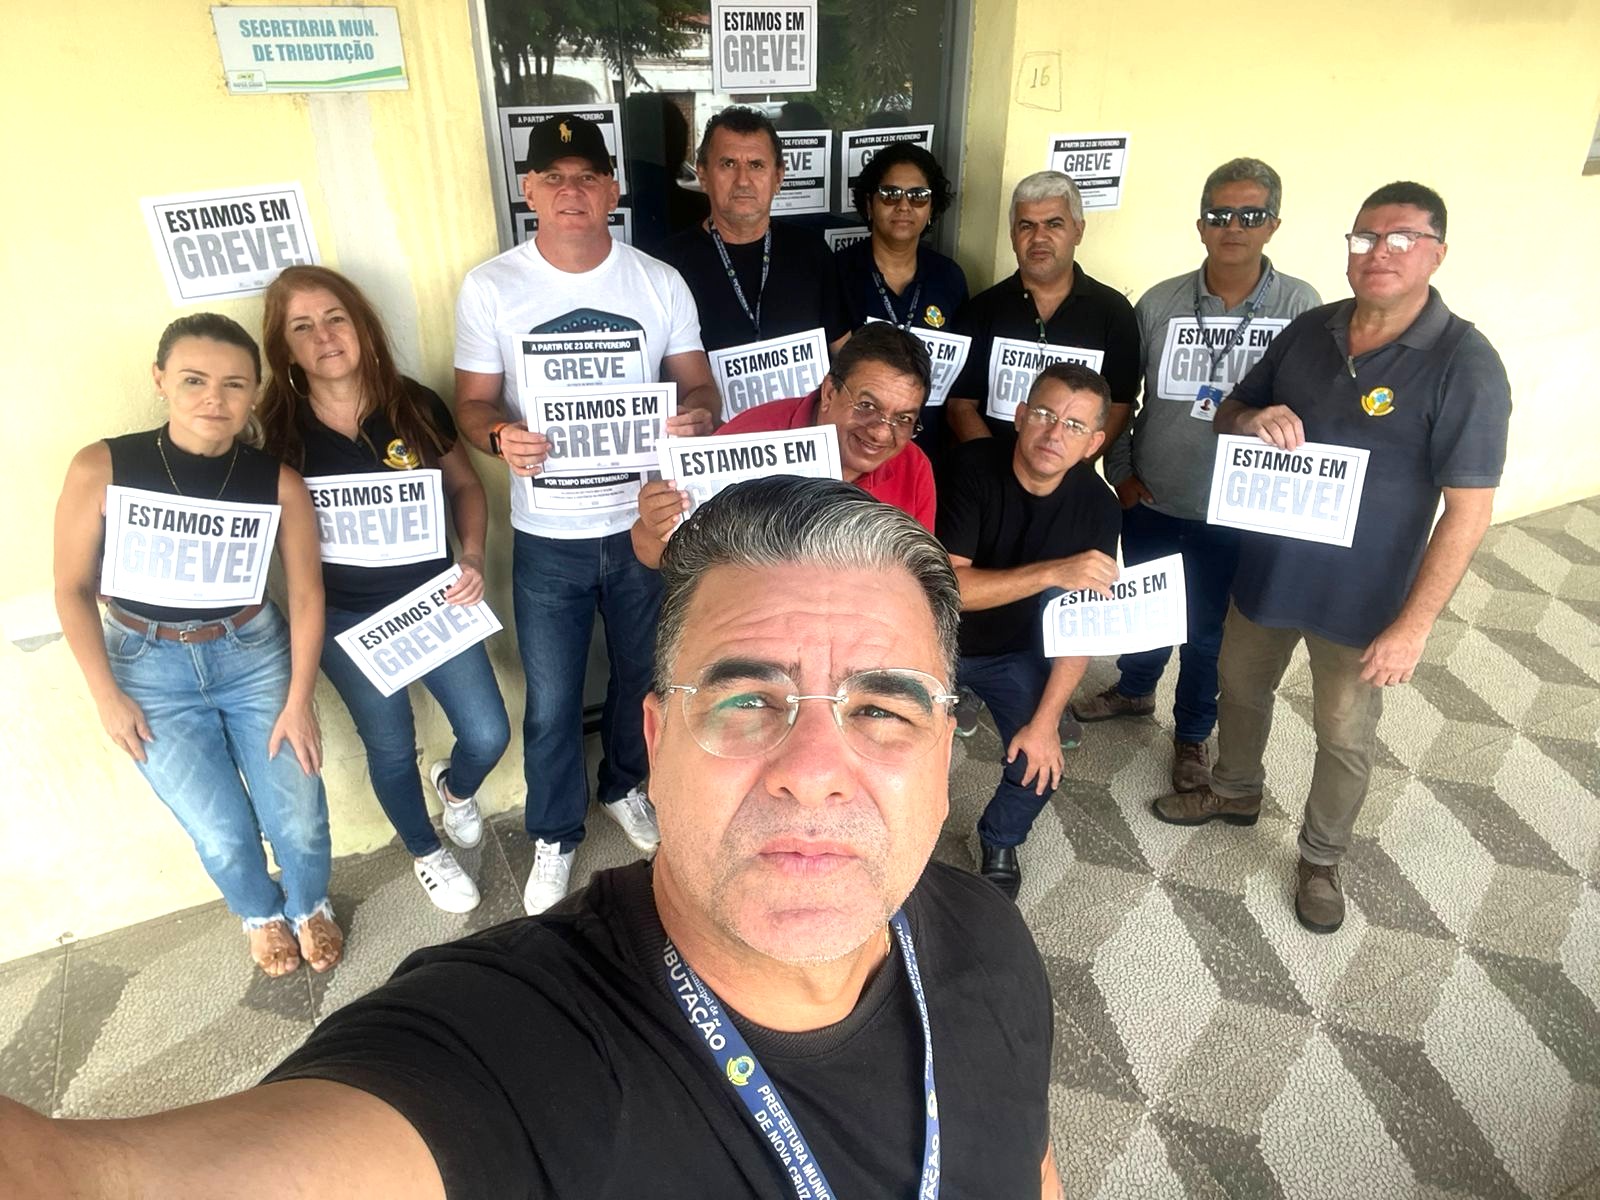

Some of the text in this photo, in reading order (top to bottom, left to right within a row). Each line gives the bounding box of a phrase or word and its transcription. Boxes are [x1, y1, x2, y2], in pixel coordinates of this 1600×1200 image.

[239, 19, 379, 38] SECRETARIA MUN.
[724, 12, 804, 31] ESTAMOS EM
[252, 40, 375, 63] DE TRIBUTAÇÃO
[724, 34, 805, 73] GREVE!
[1030, 65, 1050, 89] 16
[784, 151, 812, 171] EVE
[1064, 152, 1112, 172] GREVE
[165, 198, 291, 233] ESTAMOS EM
[173, 224, 304, 280] GREVE!
[537, 343, 562, 351] PARTIR
[564, 342, 573, 350] DE
[574, 342, 583, 350] 23
[595, 341, 631, 349] FEVEREIRO
[937, 342, 956, 361] EM
[1249, 329, 1273, 347] EM
[544, 356, 625, 381] GREVE
[725, 342, 813, 378] ESTAMOS EM
[544, 396, 658, 421] ESTAMOS EM
[546, 417, 661, 459] GREVE!
[680, 440, 816, 477] ESTAMOS EM
[1232, 448, 1348, 480] ESTAMOS EM
[310, 481, 425, 508] ESTAMOS EM
[558, 478, 579, 486] TEMPO
[580, 473, 629, 485] INDETERMINADO
[1226, 470, 1345, 521] GREVE!
[128, 503, 260, 538] ESTAMOS EM
[316, 504, 430, 546] GREVE!
[123, 530, 258, 584] GREVE!
[1143, 572, 1167, 594] EM
[358, 600, 432, 651] ESTAMOS
[373, 603, 479, 677] GREVE!
[895, 921, 918, 992] MUNICIPAL
[757, 1084, 808, 1165] PREFEITURA
[754, 1110, 811, 1200] DE NOVA CRUZ
